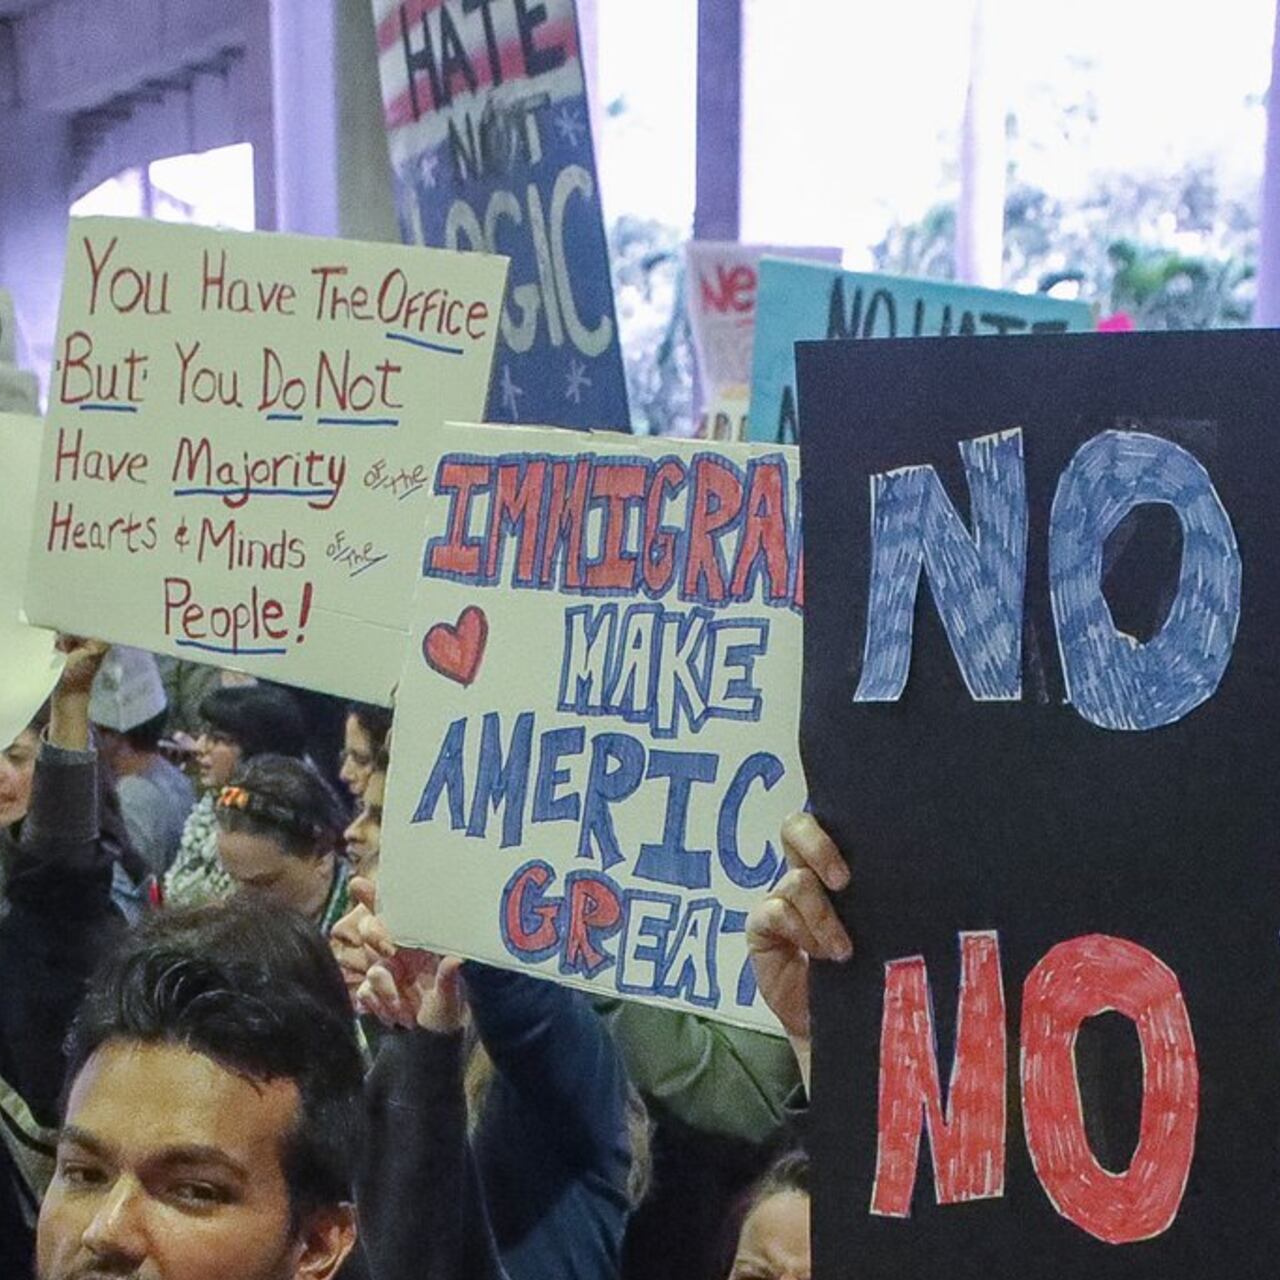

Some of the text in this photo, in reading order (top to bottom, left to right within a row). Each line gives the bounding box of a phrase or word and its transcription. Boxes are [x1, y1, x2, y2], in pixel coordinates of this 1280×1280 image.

[401, 0, 566, 122] HATE
[83, 237, 171, 315] You
[203, 250, 296, 321] Have
[311, 266, 373, 320] The
[176, 342, 244, 408] You
[258, 348, 306, 412] Do
[315, 350, 402, 411] Not
[55, 428, 148, 484] Have
[172, 437, 345, 509] Majority
[47, 502, 157, 553] Hearts
[197, 518, 306, 570] Minds
[423, 451, 805, 616] IMMIGRA
[851, 426, 1244, 731] NO
[164, 577, 313, 655] People!
[557, 602, 770, 738] MAKE
[410, 711, 790, 891] AMERIC
[870, 929, 1199, 1245] NO
